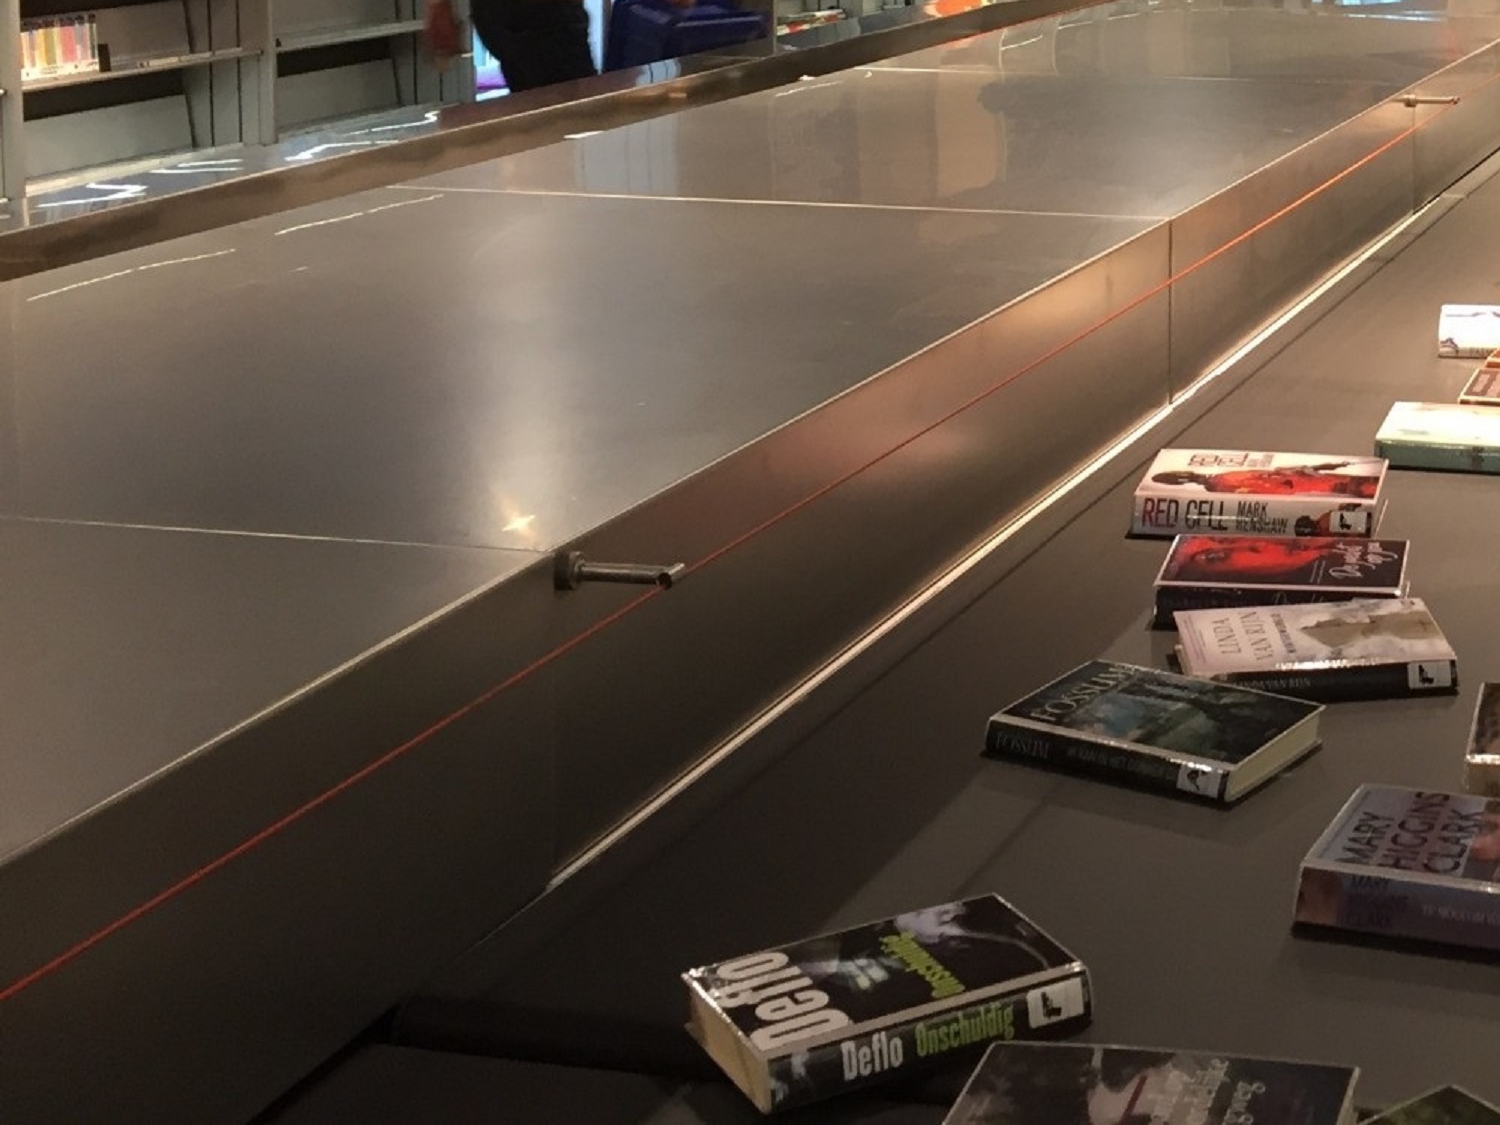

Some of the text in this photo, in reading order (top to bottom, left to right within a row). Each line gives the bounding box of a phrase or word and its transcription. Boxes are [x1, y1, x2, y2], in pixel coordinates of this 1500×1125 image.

[1141, 497, 1228, 531] RED CELL
[1235, 517, 1289, 534] HENSHAW
[1236, 501, 1269, 518] MARK
[1334, 811, 1395, 866] MARY
[1376, 791, 1450, 870] HIGGINS
[1422, 809, 1485, 873] CLARK
[717, 951, 854, 1052] Deflo
[841, 1001, 1014, 1082] Deflo Onschuldig
